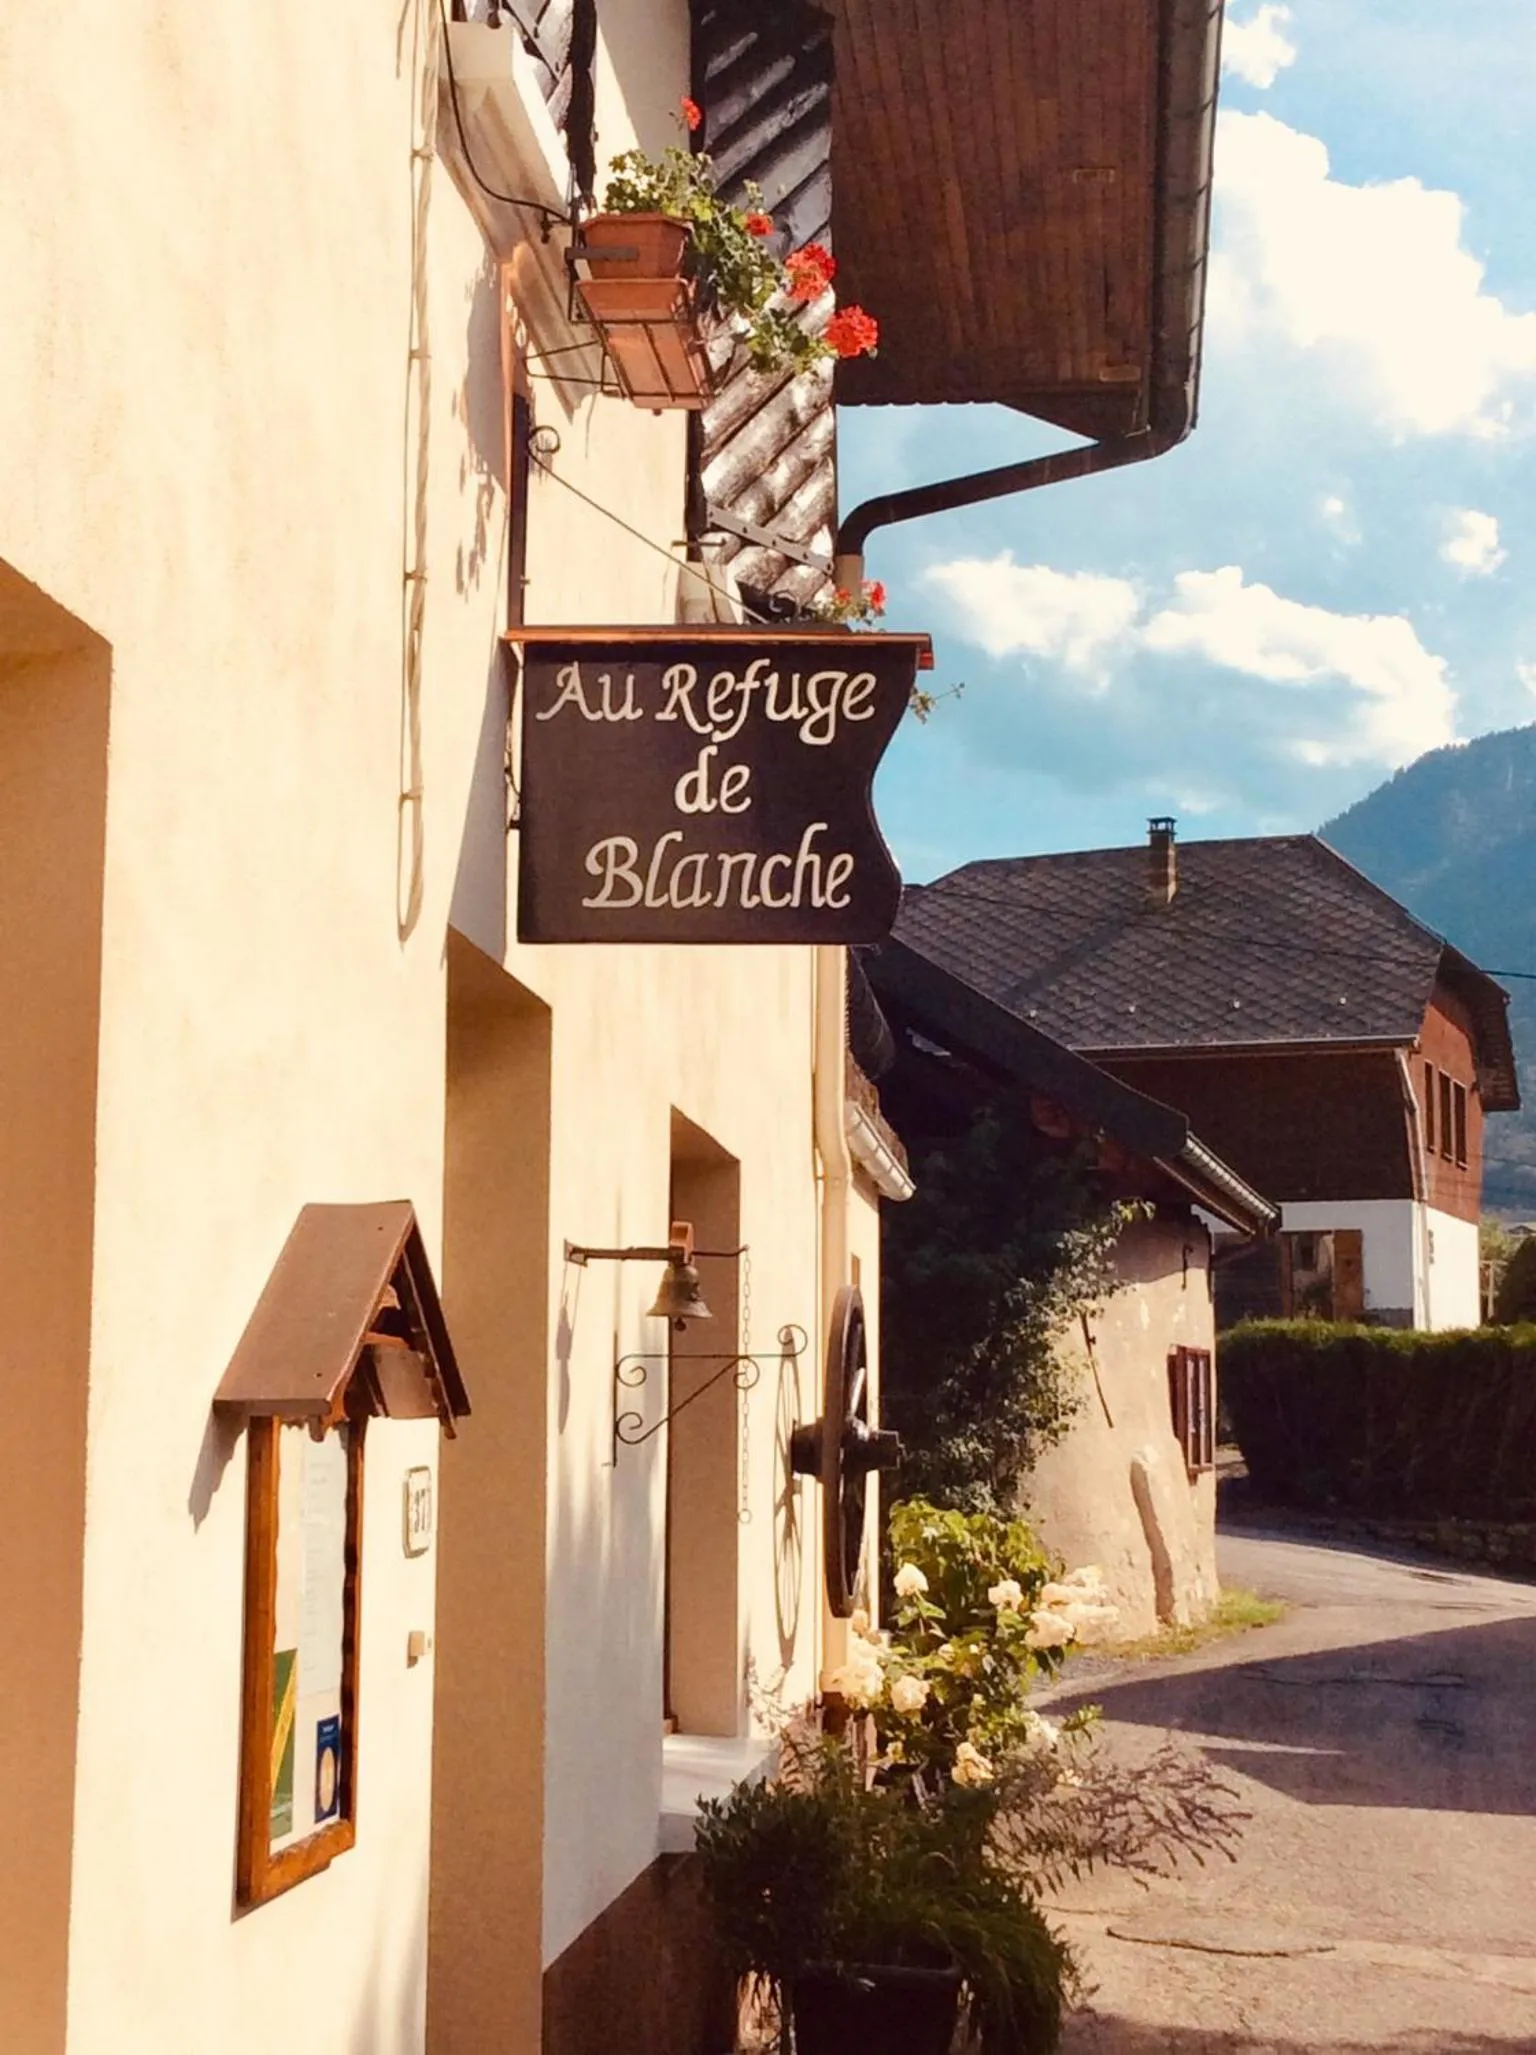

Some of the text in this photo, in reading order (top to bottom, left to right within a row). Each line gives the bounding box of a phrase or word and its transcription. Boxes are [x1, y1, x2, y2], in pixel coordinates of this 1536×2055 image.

[536, 659, 876, 745] Au Refuge
[675, 745, 752, 813] de
[583, 823, 855, 908] Blanche
